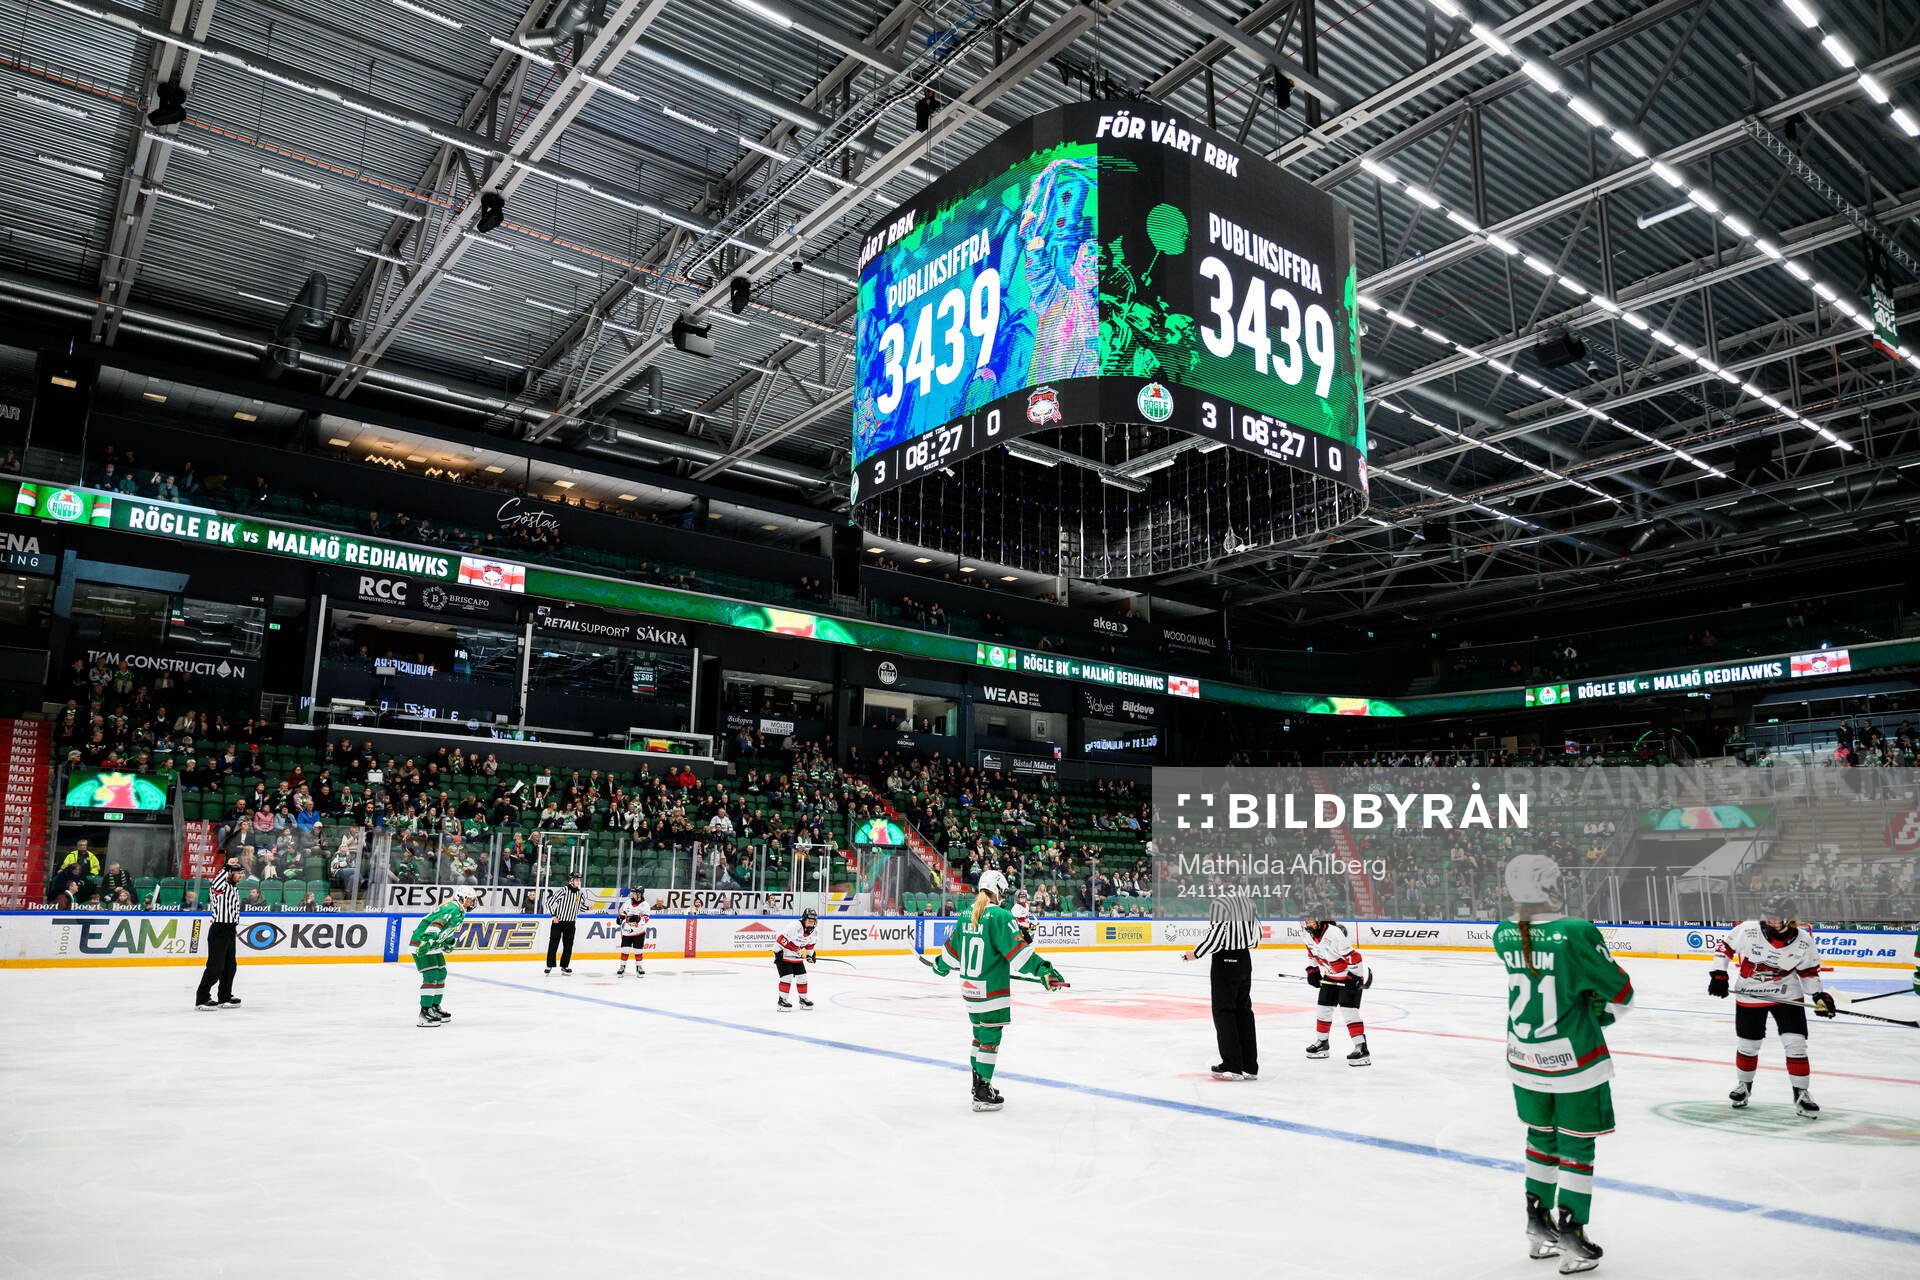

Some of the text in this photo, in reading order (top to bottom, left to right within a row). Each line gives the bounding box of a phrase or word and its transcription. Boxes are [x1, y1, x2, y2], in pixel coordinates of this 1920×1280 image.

[1097, 111, 1239, 178] FÖR VÅRT RBK
[888, 209, 916, 244] RBK
[1209, 212, 1322, 294] PUBLIKSIFFRA
[887, 228, 990, 314] PUBLIKSIFFRA
[1200, 256, 1335, 399] 3439
[877, 267, 1001, 414] 3439
[1202, 402, 1342, 472] 3 08:27 0
[874, 410, 1000, 484] 3 08:27 0
[496, 497, 560, 530] Göstas
[130, 506, 199, 537] RÖGLE
[206, 521, 236, 544] BK
[268, 530, 340, 560] MALMÖ
[346, 544, 448, 578] REDHAWKS
[358, 576, 408, 600] RCC
[432, 594, 439, 602] B
[448, 594, 490, 606] BRISCAPO
[1093, 617, 1118, 631] akea
[636, 626, 688, 646] SÄKRA
[1163, 630, 1216, 648] WOOD ON WALL
[1024, 654, 1054, 674] RÖGLE
[1056, 660, 1070, 676] BK
[1082, 664, 1114, 682] MALMÖ
[1116, 670, 1164, 690] REDHAWKS
[1578, 682, 1616, 699] RÖGLE
[1618, 680, 1636, 695] BK
[1654, 669, 1700, 690] MALMÖ
[1704, 662, 1782, 686] REDHAWKS
[984, 686, 1028, 704] WEAB
[11, 746, 36, 754] MAXI
[9, 764, 34, 773] MAXI
[8, 774, 34, 782] MAXI
[7, 784, 33, 792] MAXI
[5, 794, 32, 802] MAXI
[3, 826, 30, 834] MAI
[2, 836, 30, 845] MAI
[1, 848, 29, 857] MAI
[28, 902, 59, 911] Boozt
[71, 902, 101, 911] Boozt
[112, 902, 142, 911] Boozt
[153, 902, 181, 912] Boozt
[244, 904, 271, 912] Boozt
[281, 904, 308, 912] Boozt
[316, 904, 341, 913] Boozt
[52, 918, 186, 954] TEAM 42
[833, 924, 915, 944] Eyes4work
[1038, 922, 1080, 937] BJÄRE
[1467, 930, 1492, 940] Back
[1815, 936, 1857, 946] tefan
[960, 936, 985, 978] 10
[1507, 973, 1558, 1039] 21
[1535, 1052, 1573, 1066] Design
